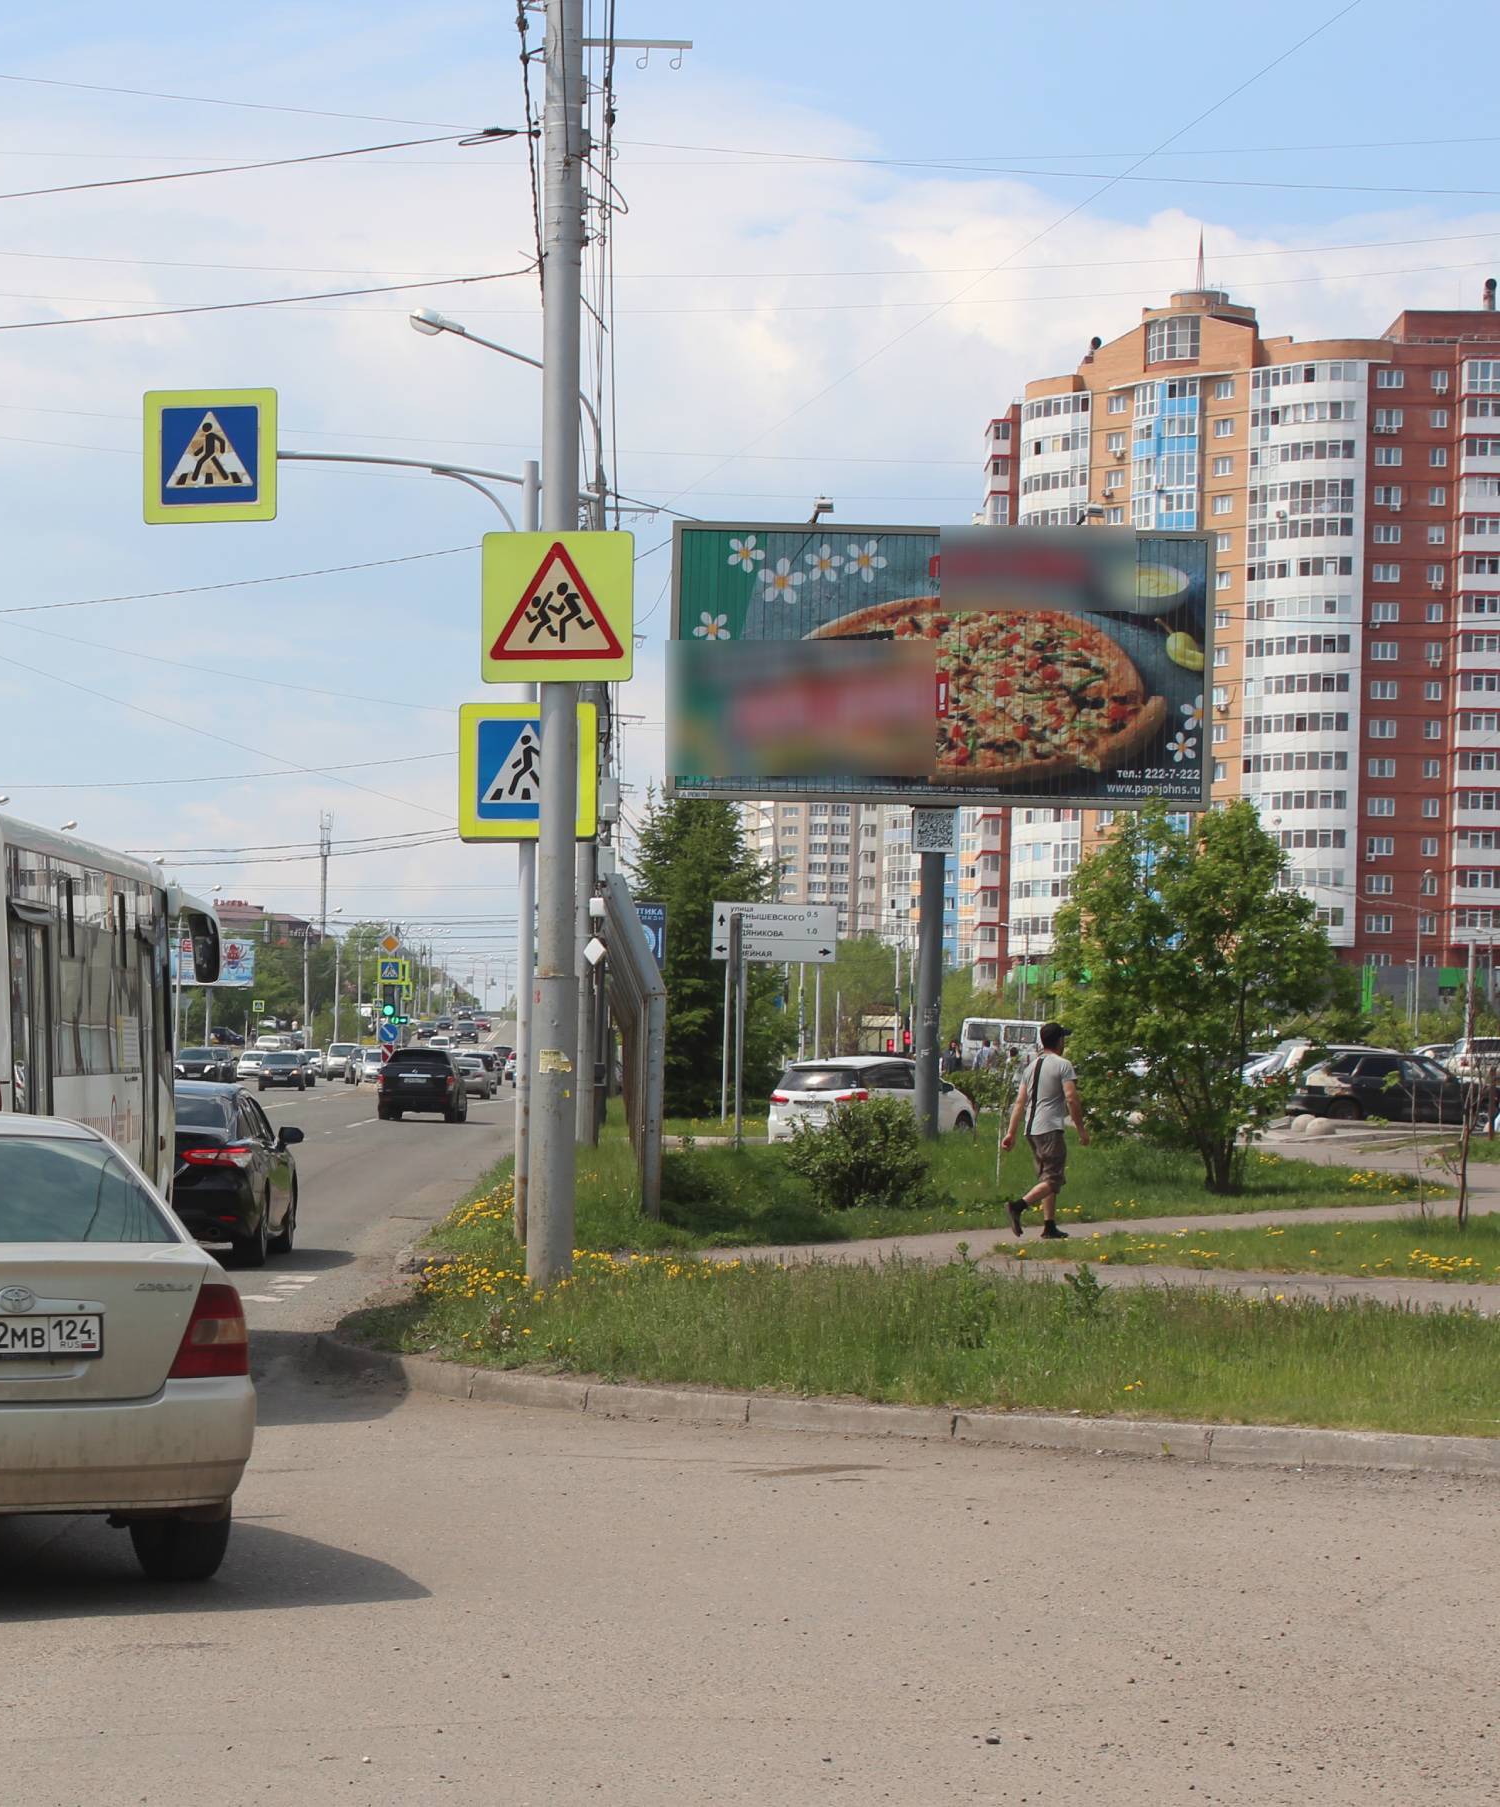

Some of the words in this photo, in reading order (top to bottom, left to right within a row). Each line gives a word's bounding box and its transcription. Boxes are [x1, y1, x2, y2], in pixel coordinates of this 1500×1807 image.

[1117, 769, 1142, 779] тел.:
[1144, 768, 1200, 780] 222-7-222
[740, 913, 805, 922] РНЫШЕВСКОГО
[53, 1320, 91, 1339] 124
